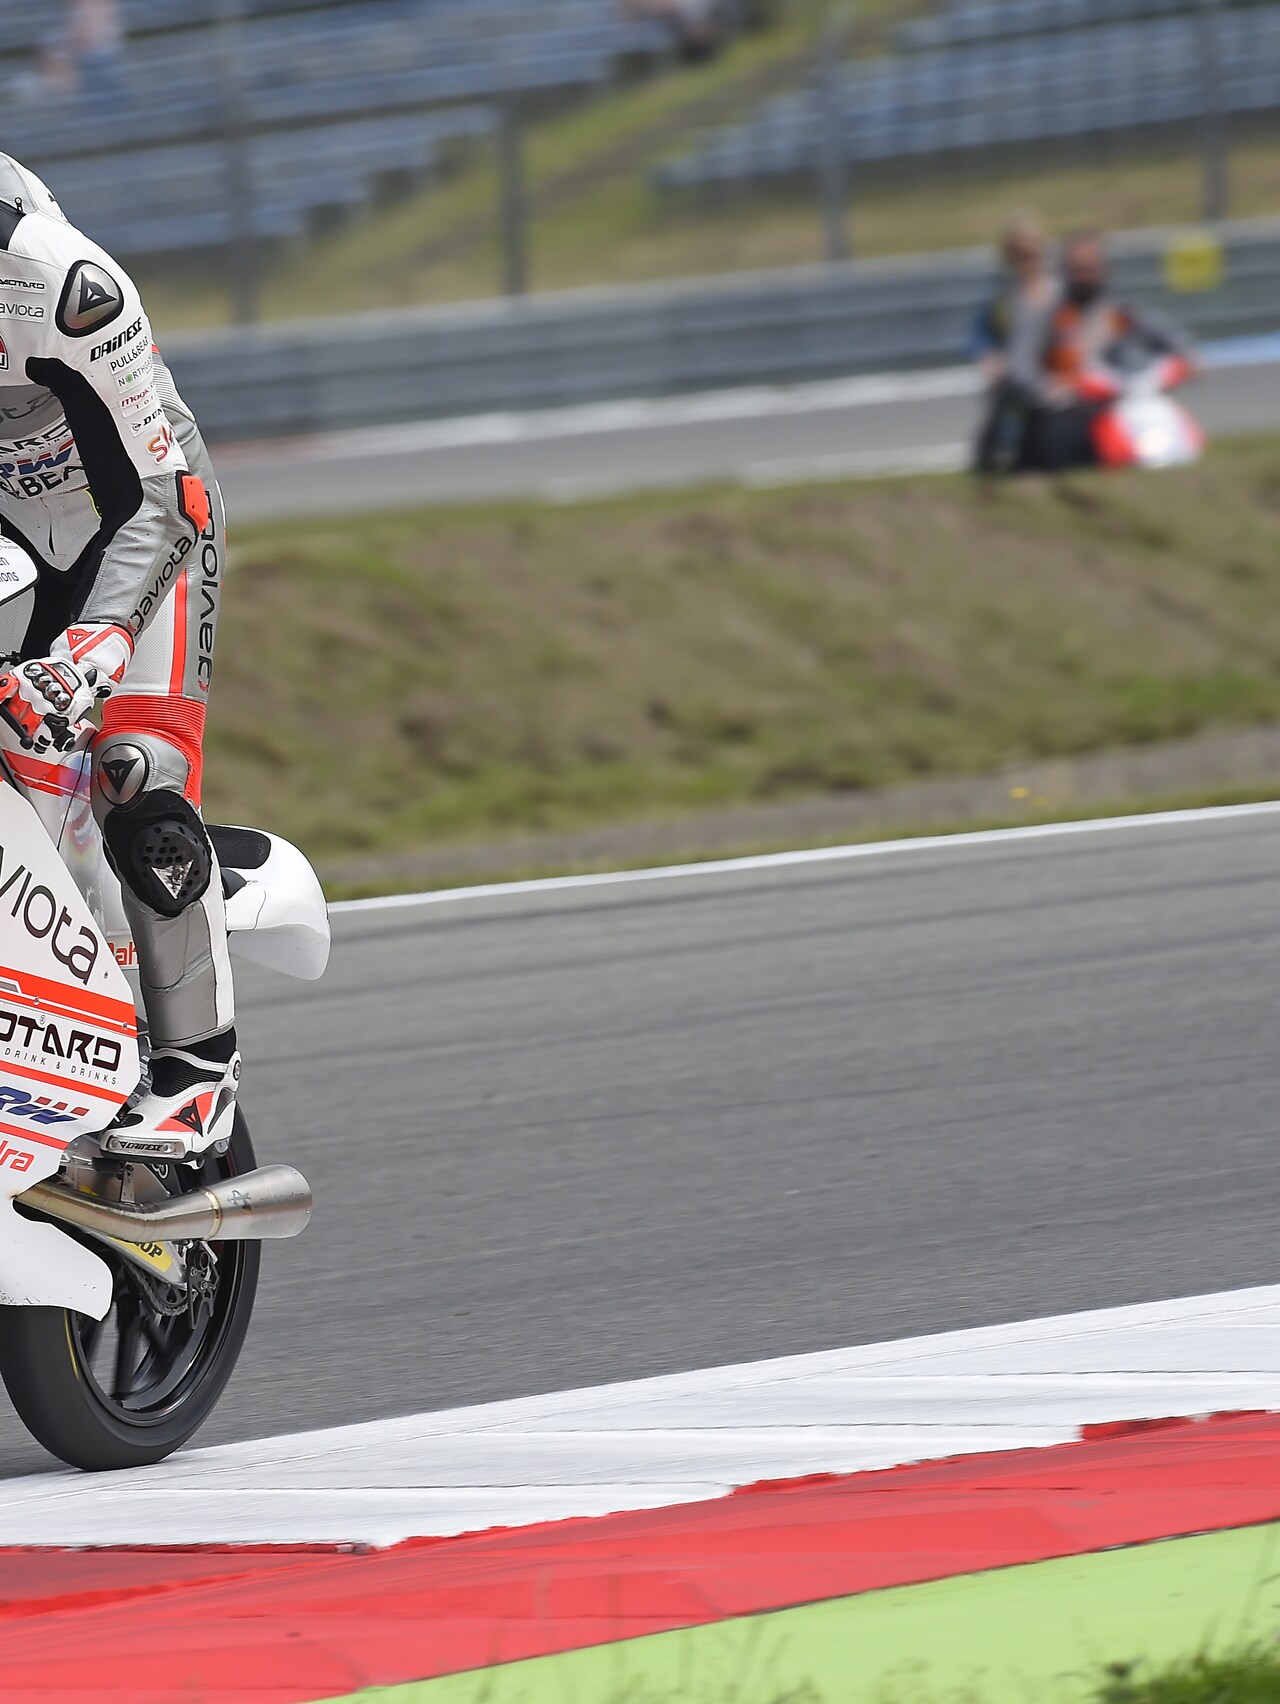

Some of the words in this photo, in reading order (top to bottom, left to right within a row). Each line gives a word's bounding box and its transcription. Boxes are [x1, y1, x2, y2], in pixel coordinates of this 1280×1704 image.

[90, 316, 143, 362] DAINESE
[127, 536, 192, 636] gaviota
[5, 1047, 47, 1066] DRINK
[55, 1061, 62, 1070] &
[71, 1065, 117, 1085] DRINKS
